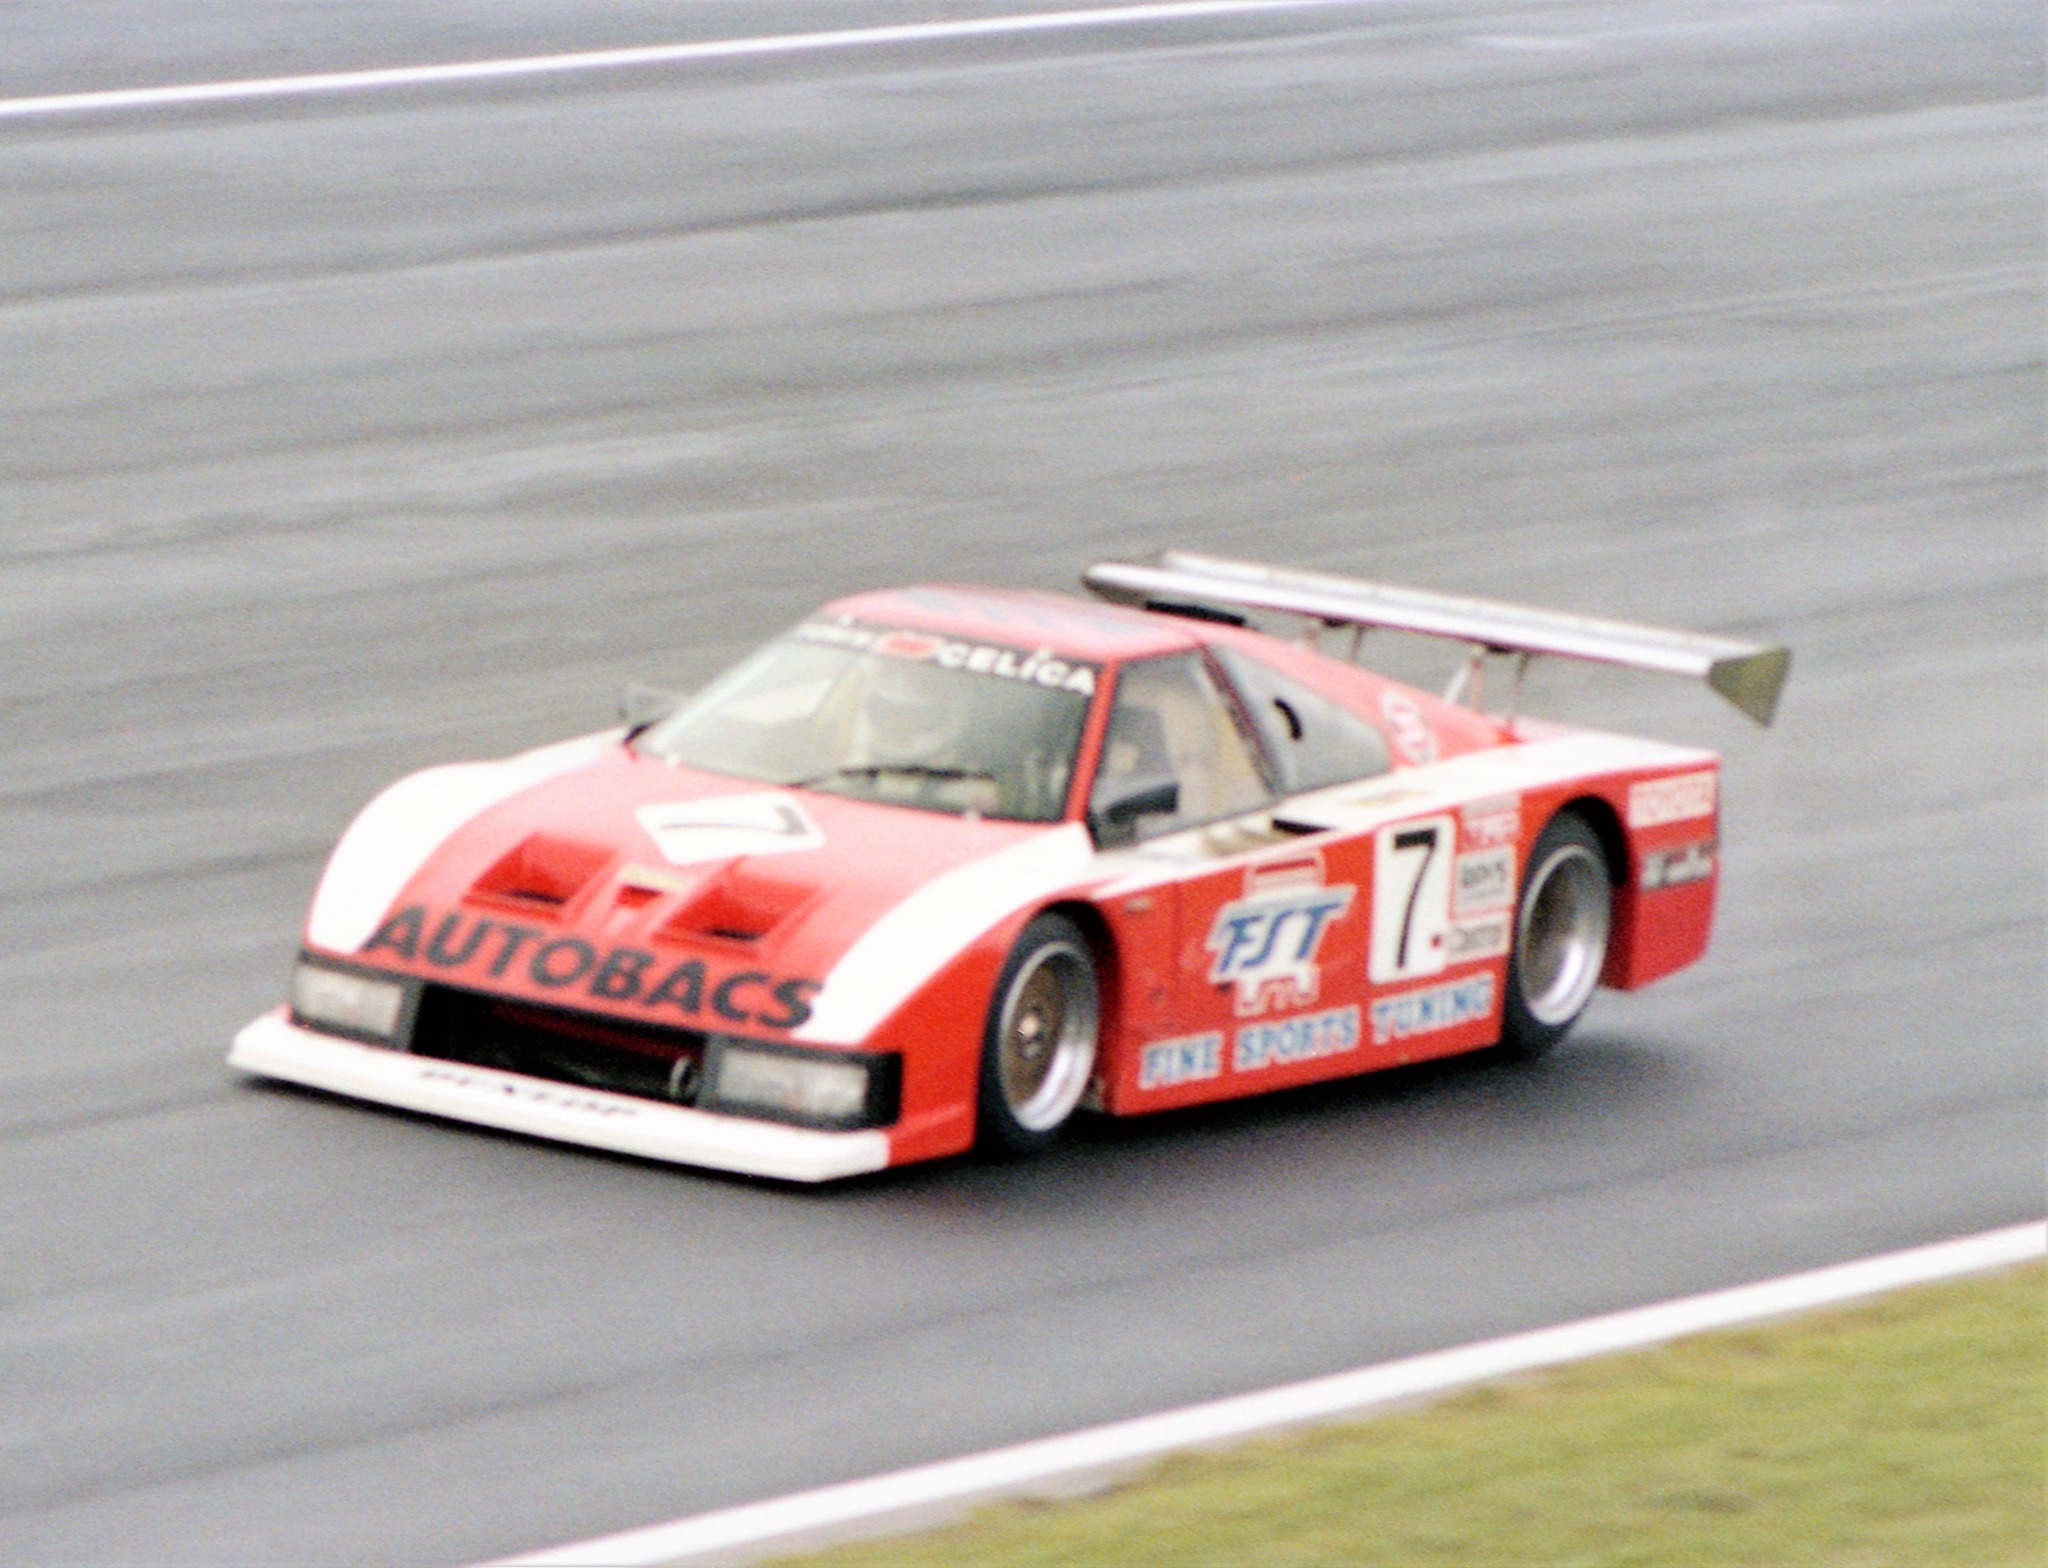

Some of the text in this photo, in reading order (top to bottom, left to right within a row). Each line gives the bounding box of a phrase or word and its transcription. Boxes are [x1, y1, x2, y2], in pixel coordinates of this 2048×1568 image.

[1394, 826, 1438, 969] 7
[362, 905, 823, 1029] AUTOBACS
[1140, 974, 1493, 1088] FINE SPORTS TUNING
